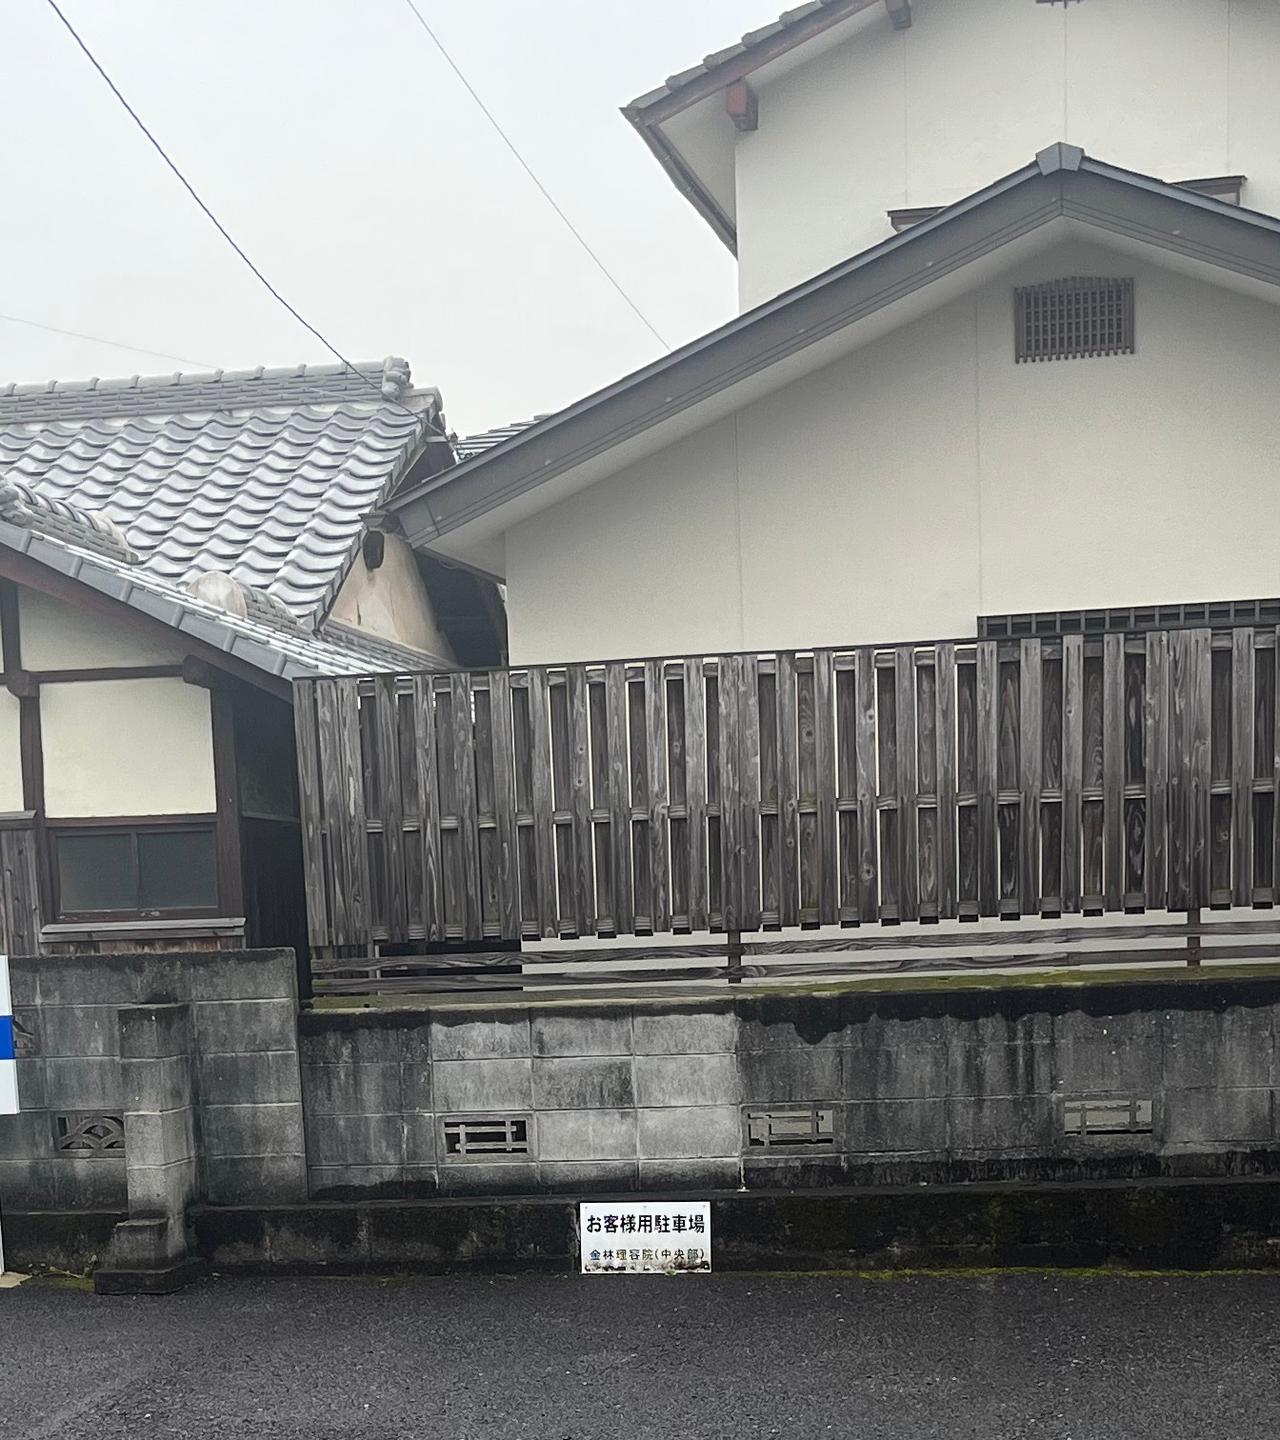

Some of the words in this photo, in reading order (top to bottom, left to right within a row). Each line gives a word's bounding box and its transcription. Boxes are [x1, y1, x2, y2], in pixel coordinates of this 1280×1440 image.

[586, 1214, 705, 1234] お客様用駐車場
